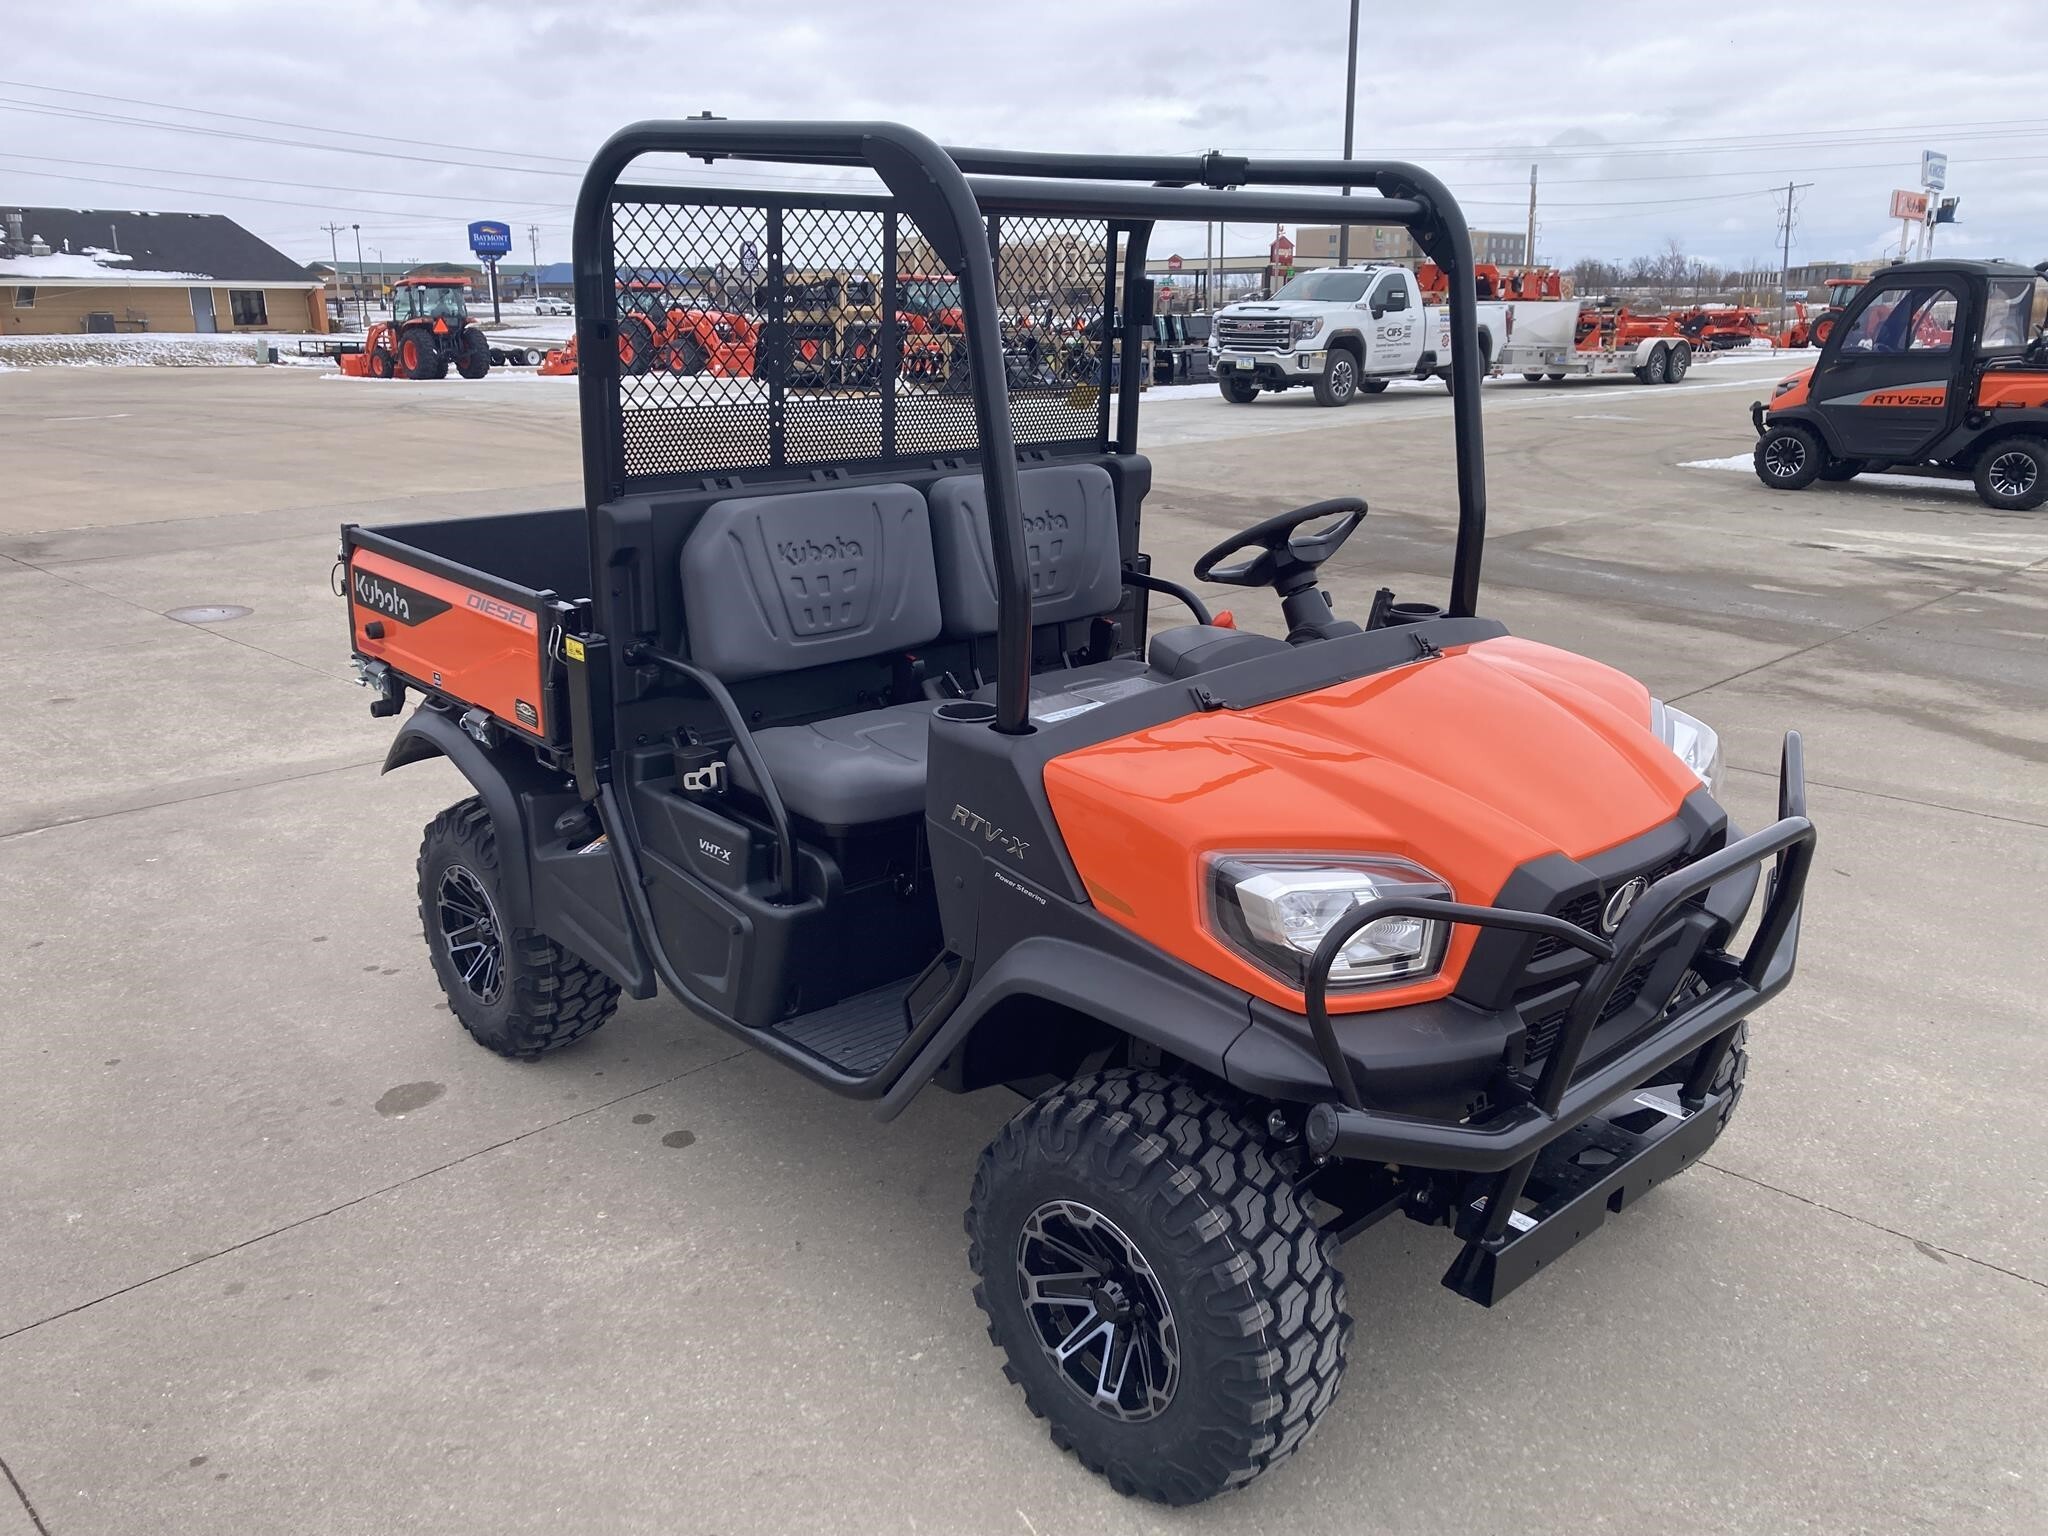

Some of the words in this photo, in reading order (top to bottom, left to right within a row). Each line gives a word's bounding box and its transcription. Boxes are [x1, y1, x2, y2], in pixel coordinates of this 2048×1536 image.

[473, 233, 508, 242] BAYMONT
[1386, 328, 1402, 337] CIFS
[1872, 395, 1944, 406] RTV520
[1022, 510, 1069, 534] bota
[777, 536, 864, 566] Kubota
[354, 572, 410, 620] Kubota
[465, 593, 532, 630] DIESEL
[951, 803, 1030, 860] RTV-X
[699, 838, 732, 861] VHT-X
[994, 871, 1017, 888] Power
[1015, 883, 1047, 905] Steering
